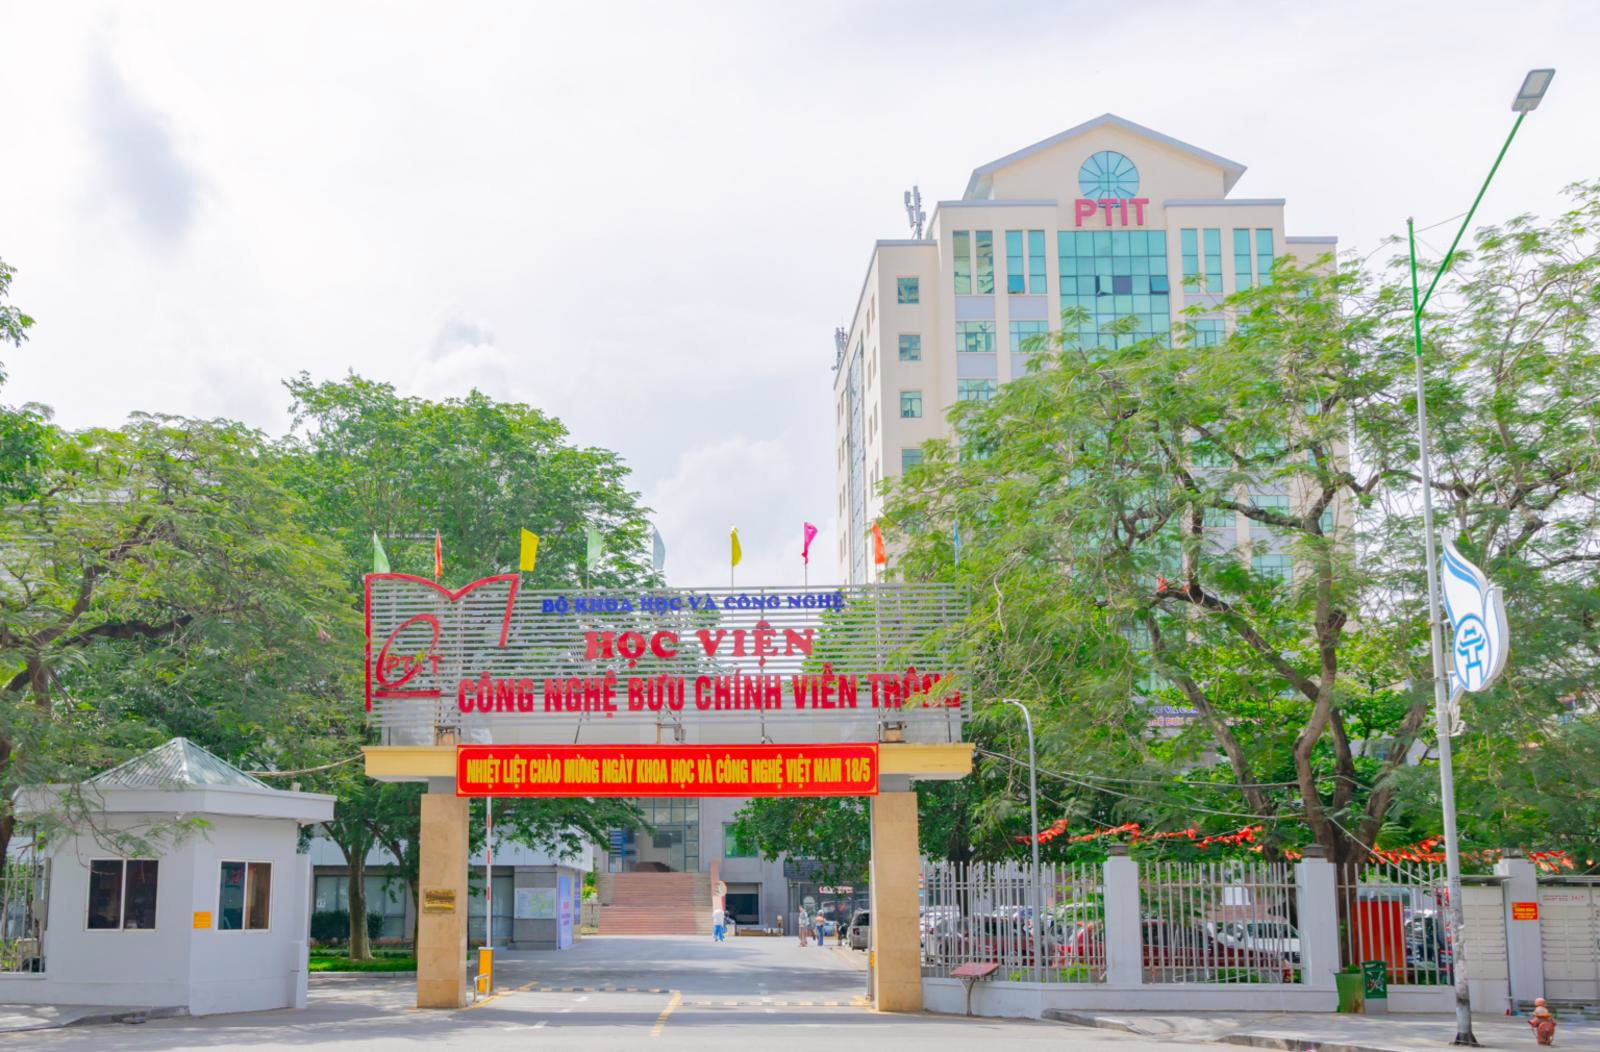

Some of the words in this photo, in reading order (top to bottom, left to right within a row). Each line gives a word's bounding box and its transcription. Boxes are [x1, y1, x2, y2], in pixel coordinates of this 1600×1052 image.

[1075, 198, 1149, 227] PTIT
[542, 595, 568, 616] BỘ
[575, 598, 634, 613] KHOA
[640, 596, 682, 616] HỌC
[688, 593, 717, 611] VÀ
[724, 593, 780, 610] CÔNG
[787, 591, 845, 613] NGHỆ
[585, 630, 679, 668] HỌC
[696, 620, 815, 667] VIỆN
[458, 671, 534, 713] CÔNG
[544, 670, 618, 718] NGHỆ
[628, 673, 684, 711] BƯU
[695, 668, 783, 711] CHÍNH
[792, 662, 857, 709] VIỄN
[466, 753, 501, 789] NHIỆT
[503, 753, 528, 789] LIỆT
[529, 753, 561, 783] CHÀO
[564, 753, 600, 784] MỪNG
[602, 753, 634, 784] NGÀY
[636, 758, 668, 784] KHOA
[671, 758, 695, 789] HỌC
[697, 753, 713, 784] VÀ
[715, 753, 749, 784] CÔNG
[751, 753, 783, 789] NGHỆ
[786, 753, 811, 789] VIỆT
[814, 758, 842, 783] NAM
[845, 757, 870, 783] 18/5
